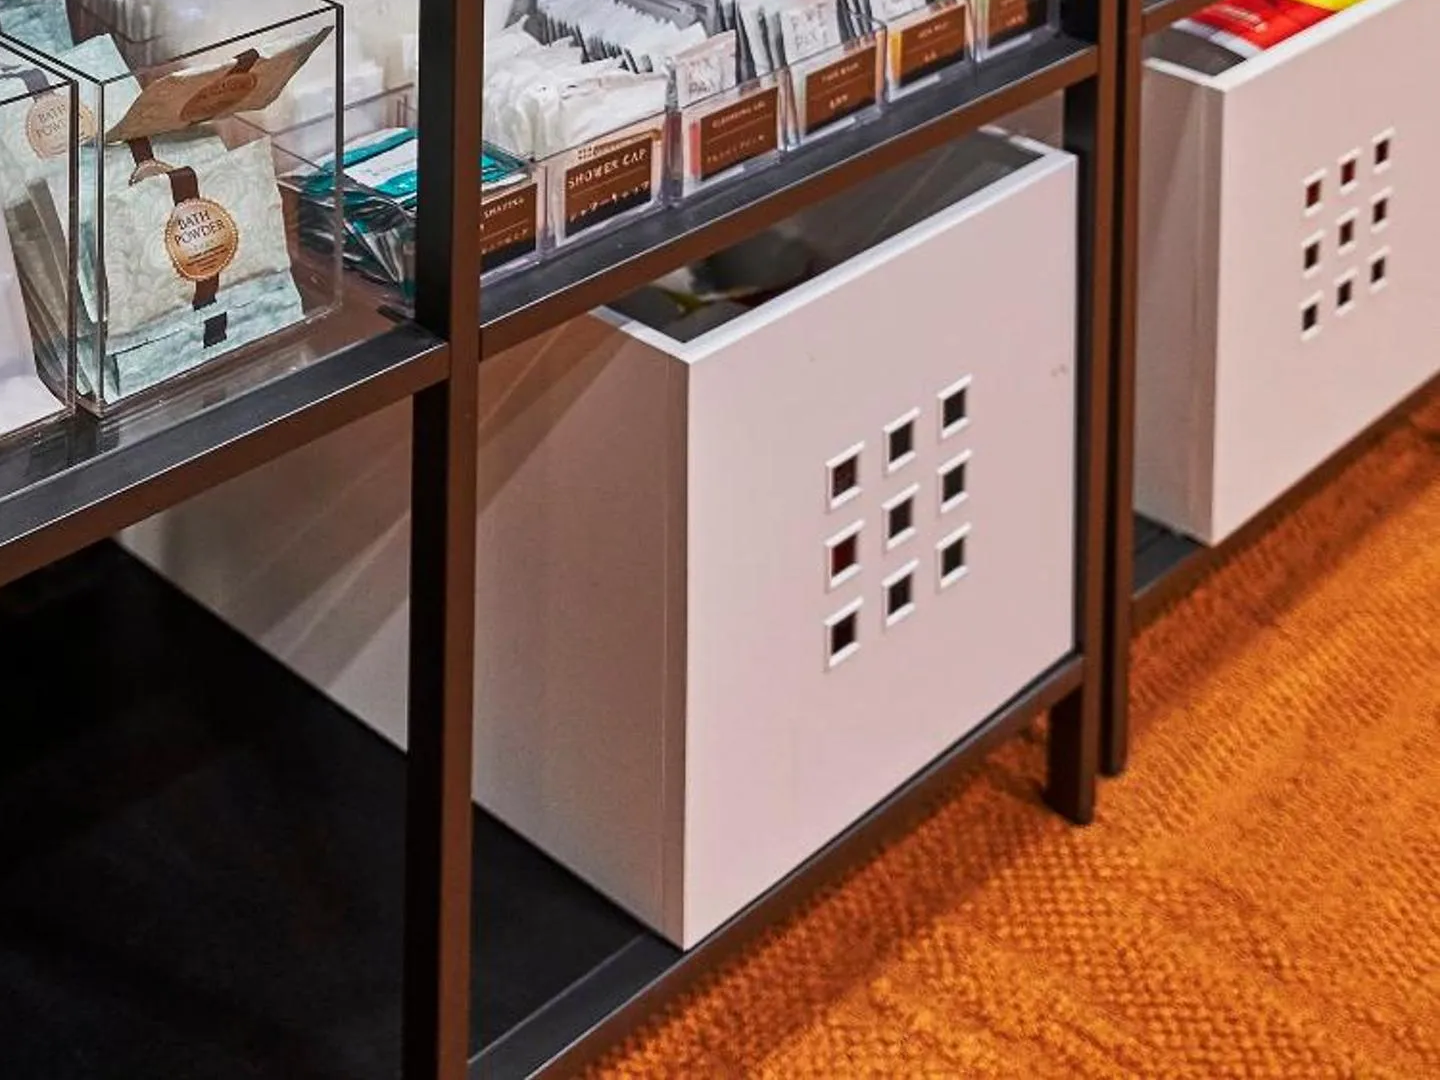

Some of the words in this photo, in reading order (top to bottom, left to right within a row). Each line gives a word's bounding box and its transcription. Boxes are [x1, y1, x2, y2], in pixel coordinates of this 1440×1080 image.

[567, 159, 620, 189] SHOWER
[622, 149, 649, 169] CAP
[175, 220, 226, 247] POWDER
[177, 210, 211, 230] BATH
